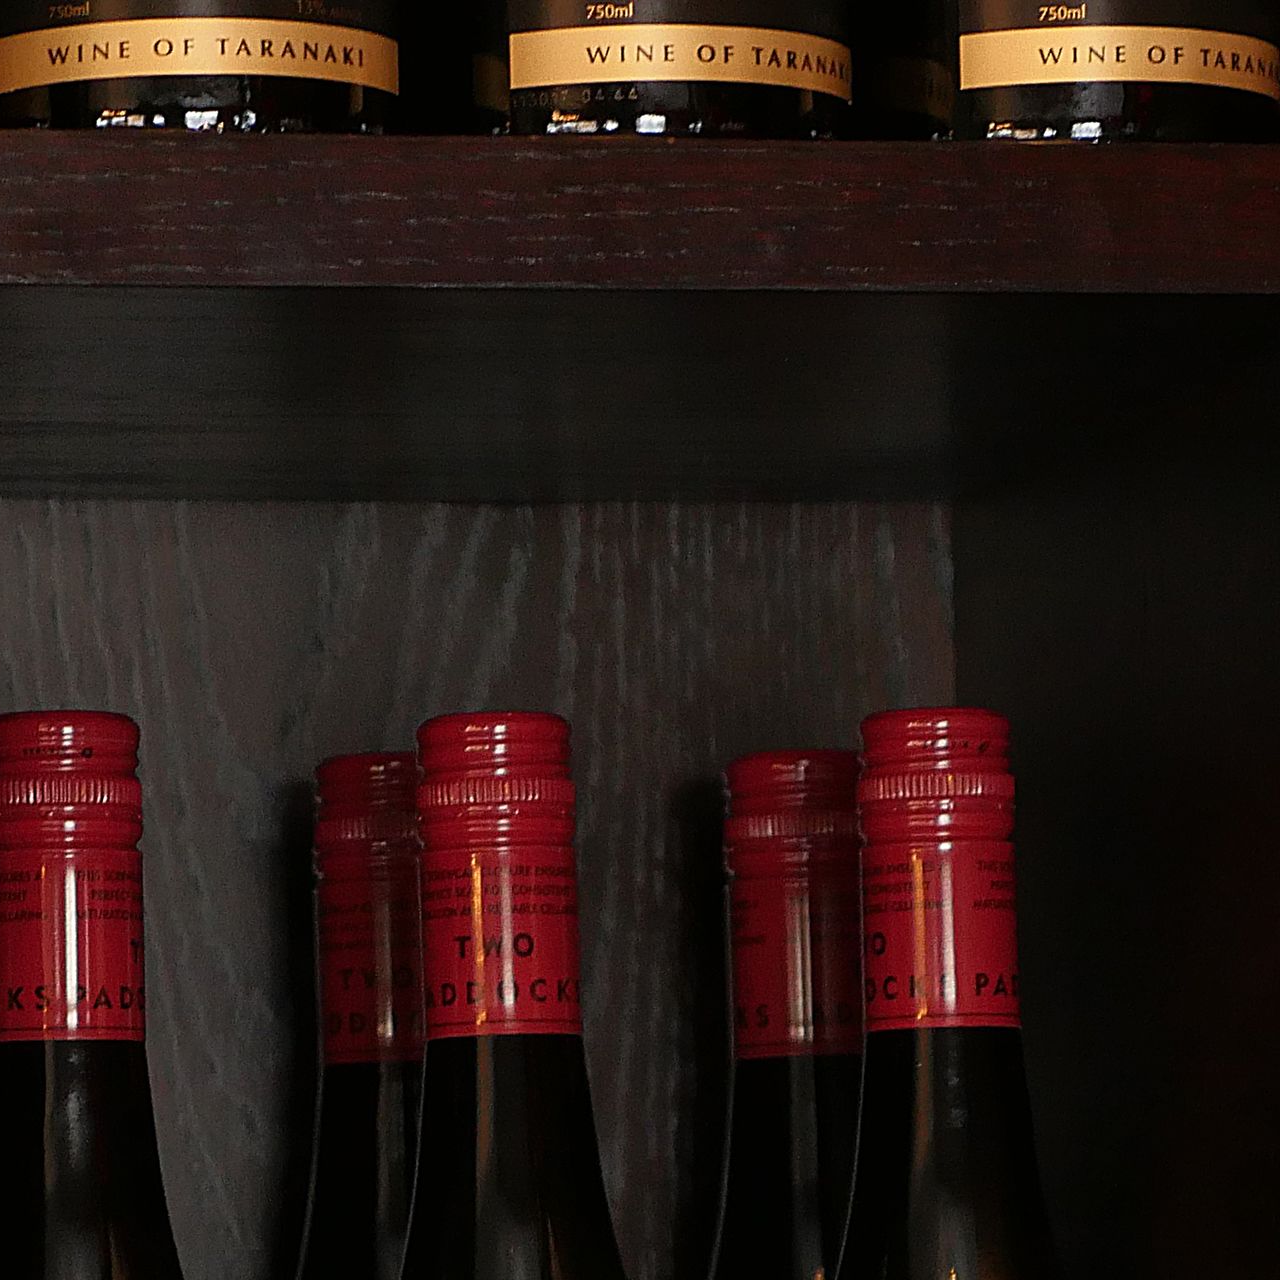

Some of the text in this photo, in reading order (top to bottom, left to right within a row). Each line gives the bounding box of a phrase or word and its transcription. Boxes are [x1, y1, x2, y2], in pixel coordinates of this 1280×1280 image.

[586, 2, 634, 20] 750ml
[1038, 3, 1087, 22] 750ml
[48, 38, 364, 67] WINE OF TARANAKI
[586, 45, 674, 64] WINE
[697, 44, 734, 64] OF
[1039, 46, 1126, 65] WINE
[1148, 46, 1184, 65] OF
